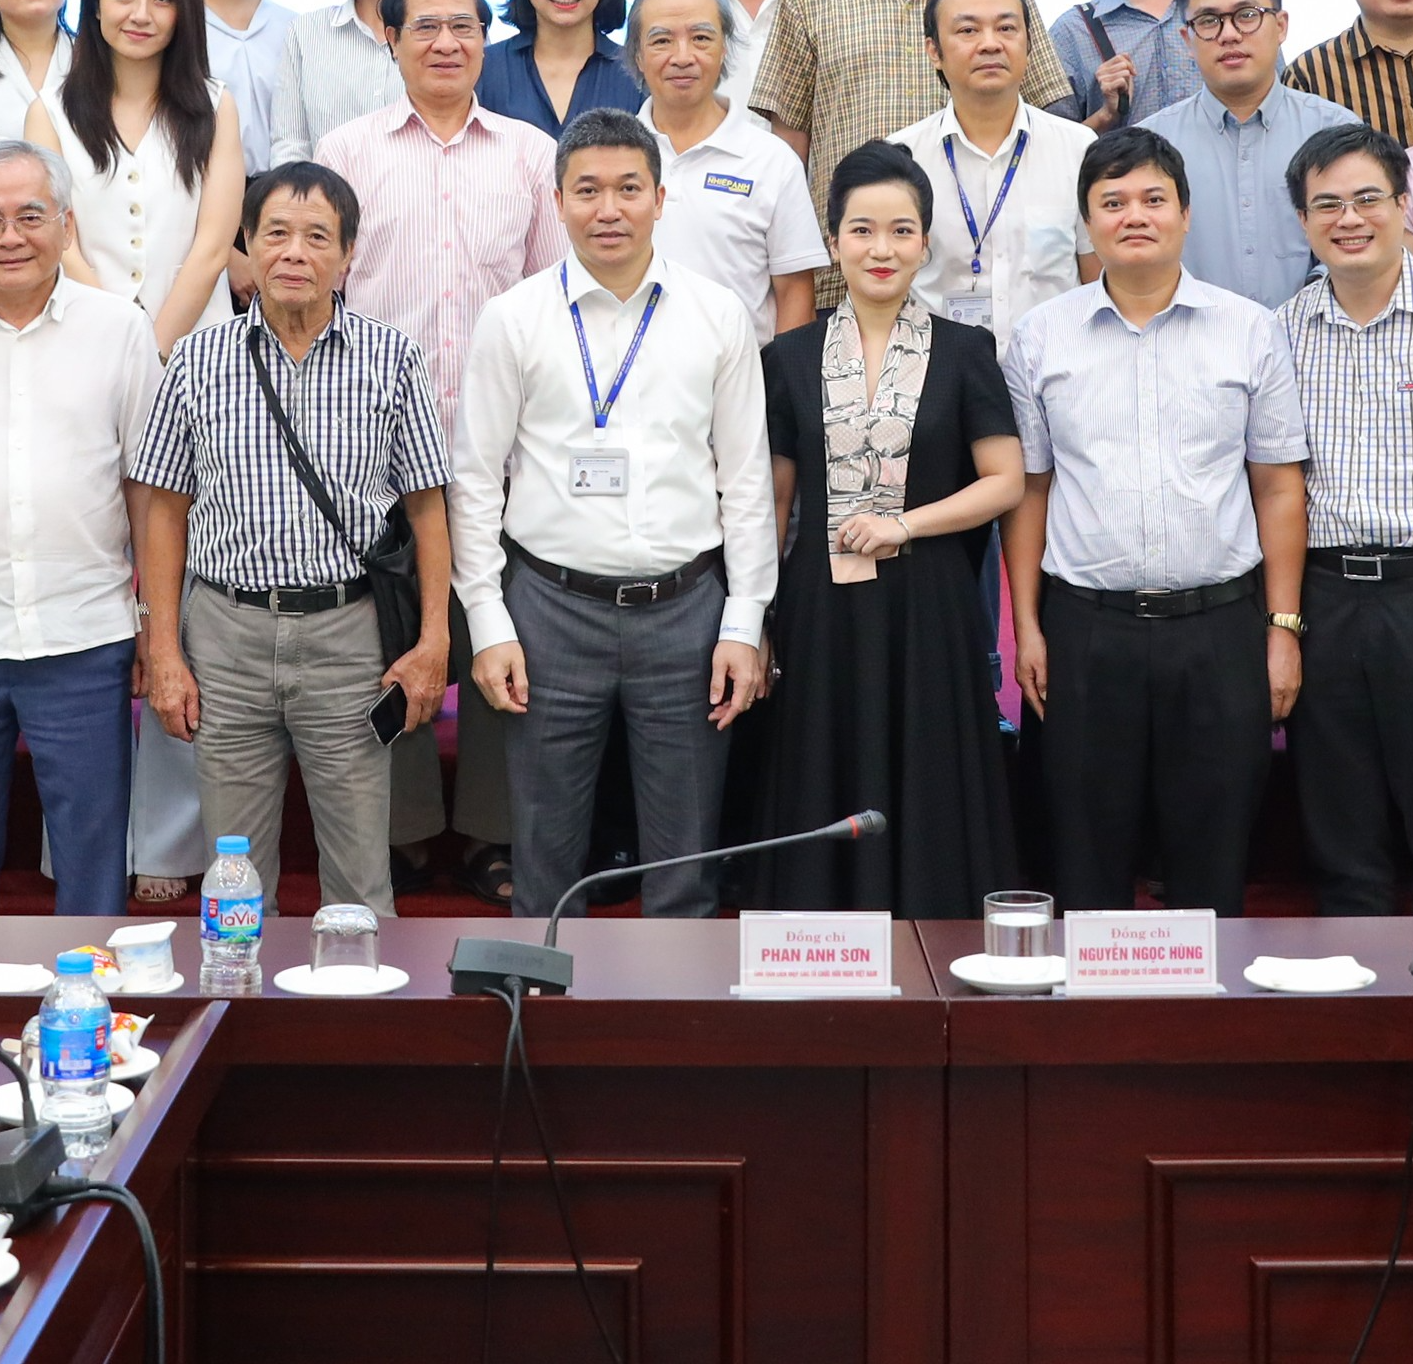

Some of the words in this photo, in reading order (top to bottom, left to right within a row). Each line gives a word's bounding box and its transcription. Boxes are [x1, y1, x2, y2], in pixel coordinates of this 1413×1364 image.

[761, 948, 801, 962] PHAN
[806, 948, 836, 962] ANH
[840, 947, 870, 962] SƠN
[1132, 946, 1165, 963] NGỌC
